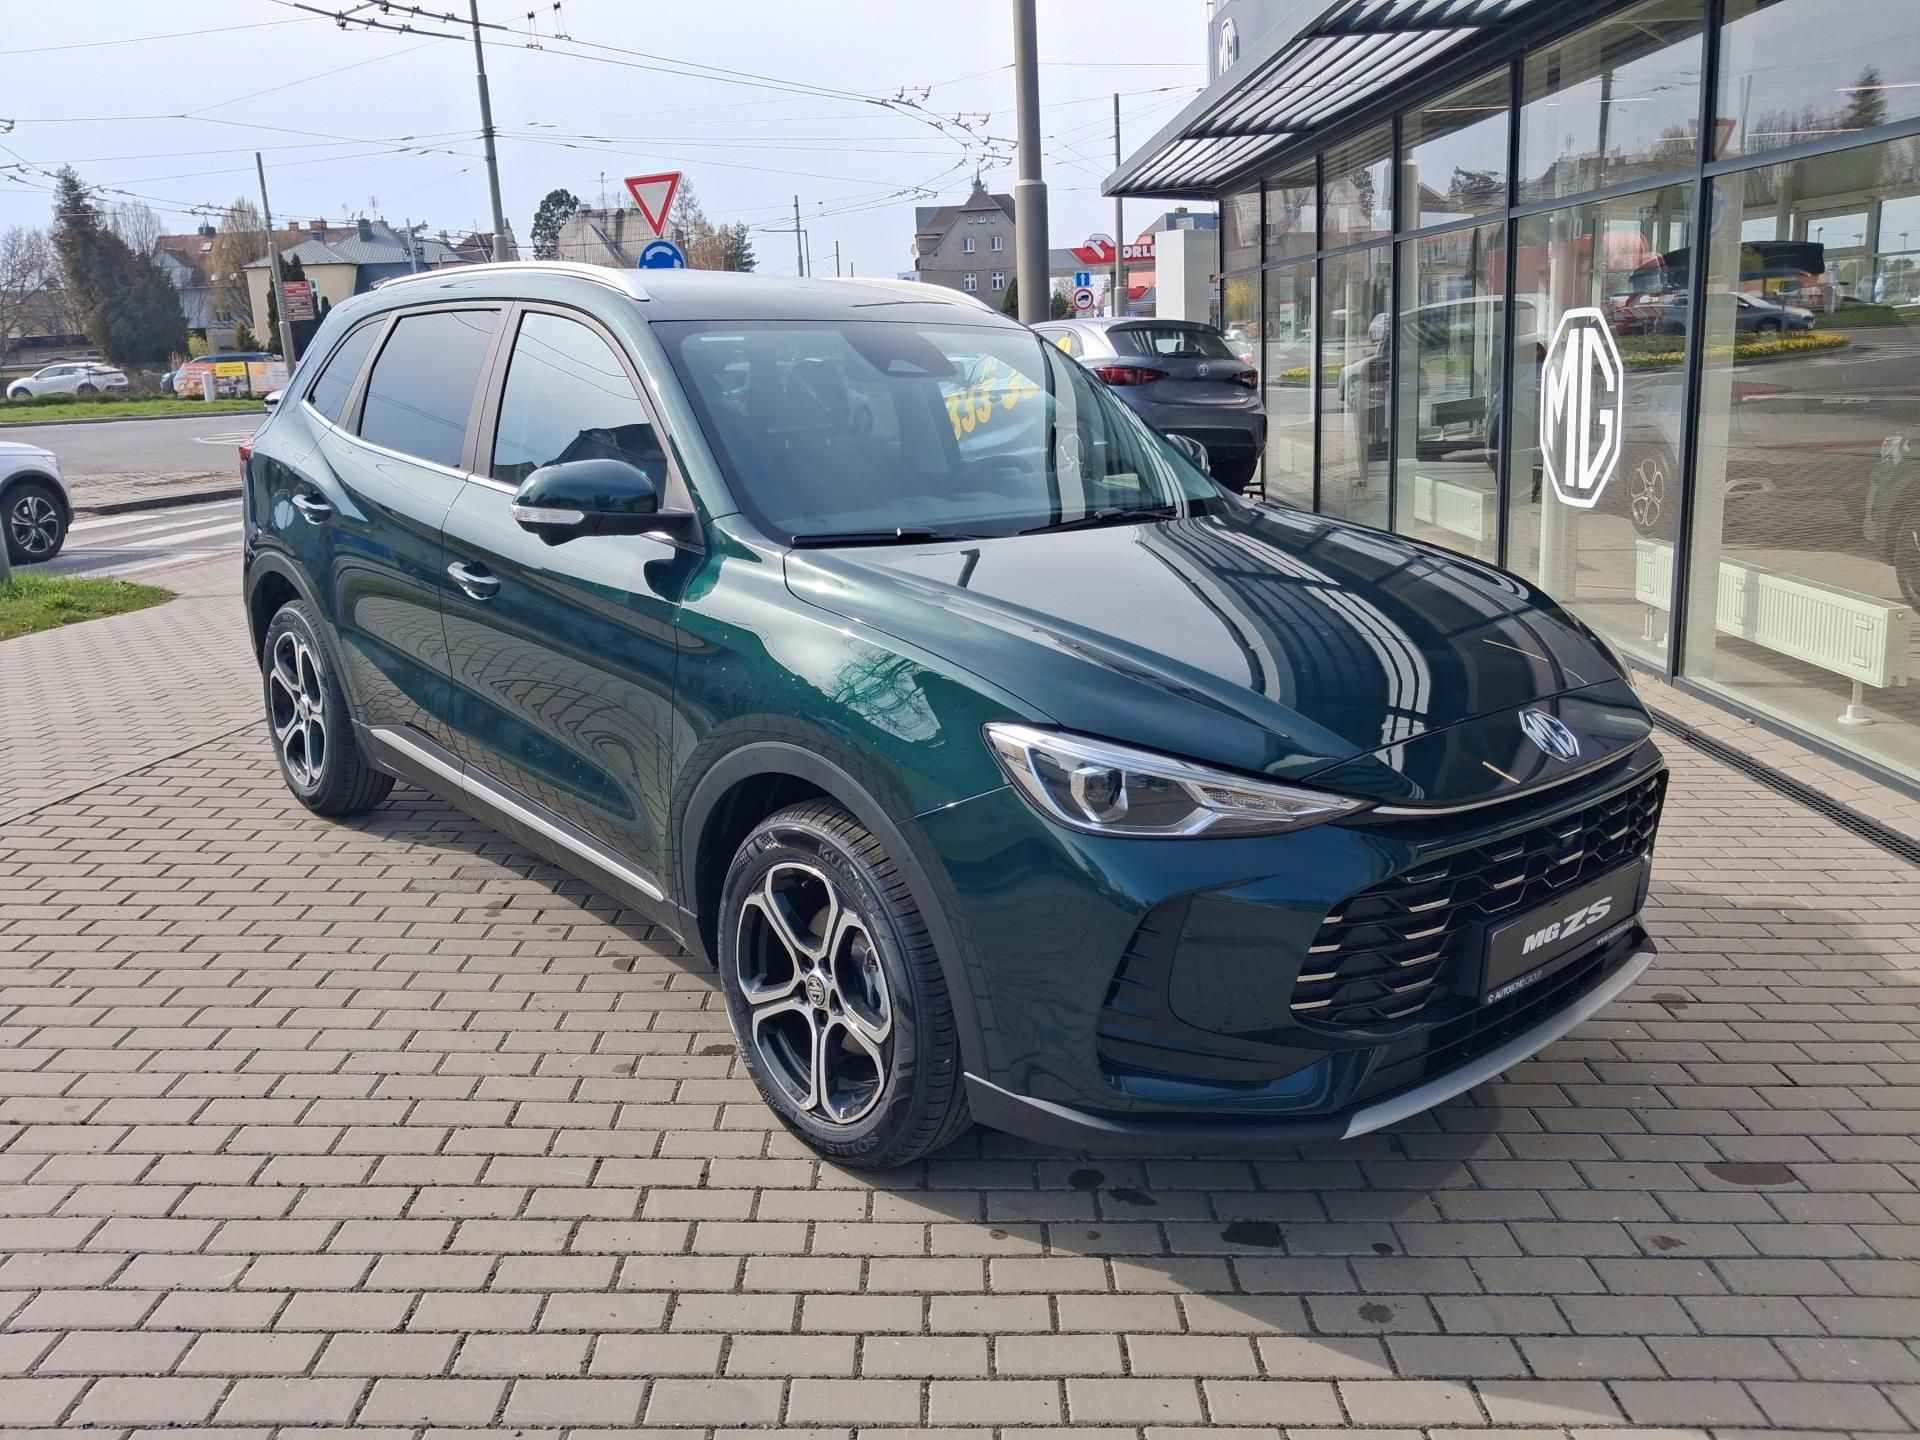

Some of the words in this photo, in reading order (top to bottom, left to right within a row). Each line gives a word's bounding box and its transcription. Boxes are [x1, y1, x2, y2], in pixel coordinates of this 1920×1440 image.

[1546, 327, 1615, 490] MG
[1525, 712, 1576, 759] MG
[1522, 922, 1561, 955] MG
[1560, 896, 1613, 940] ZS
[1495, 978, 1525, 1001] AUTOBOND
